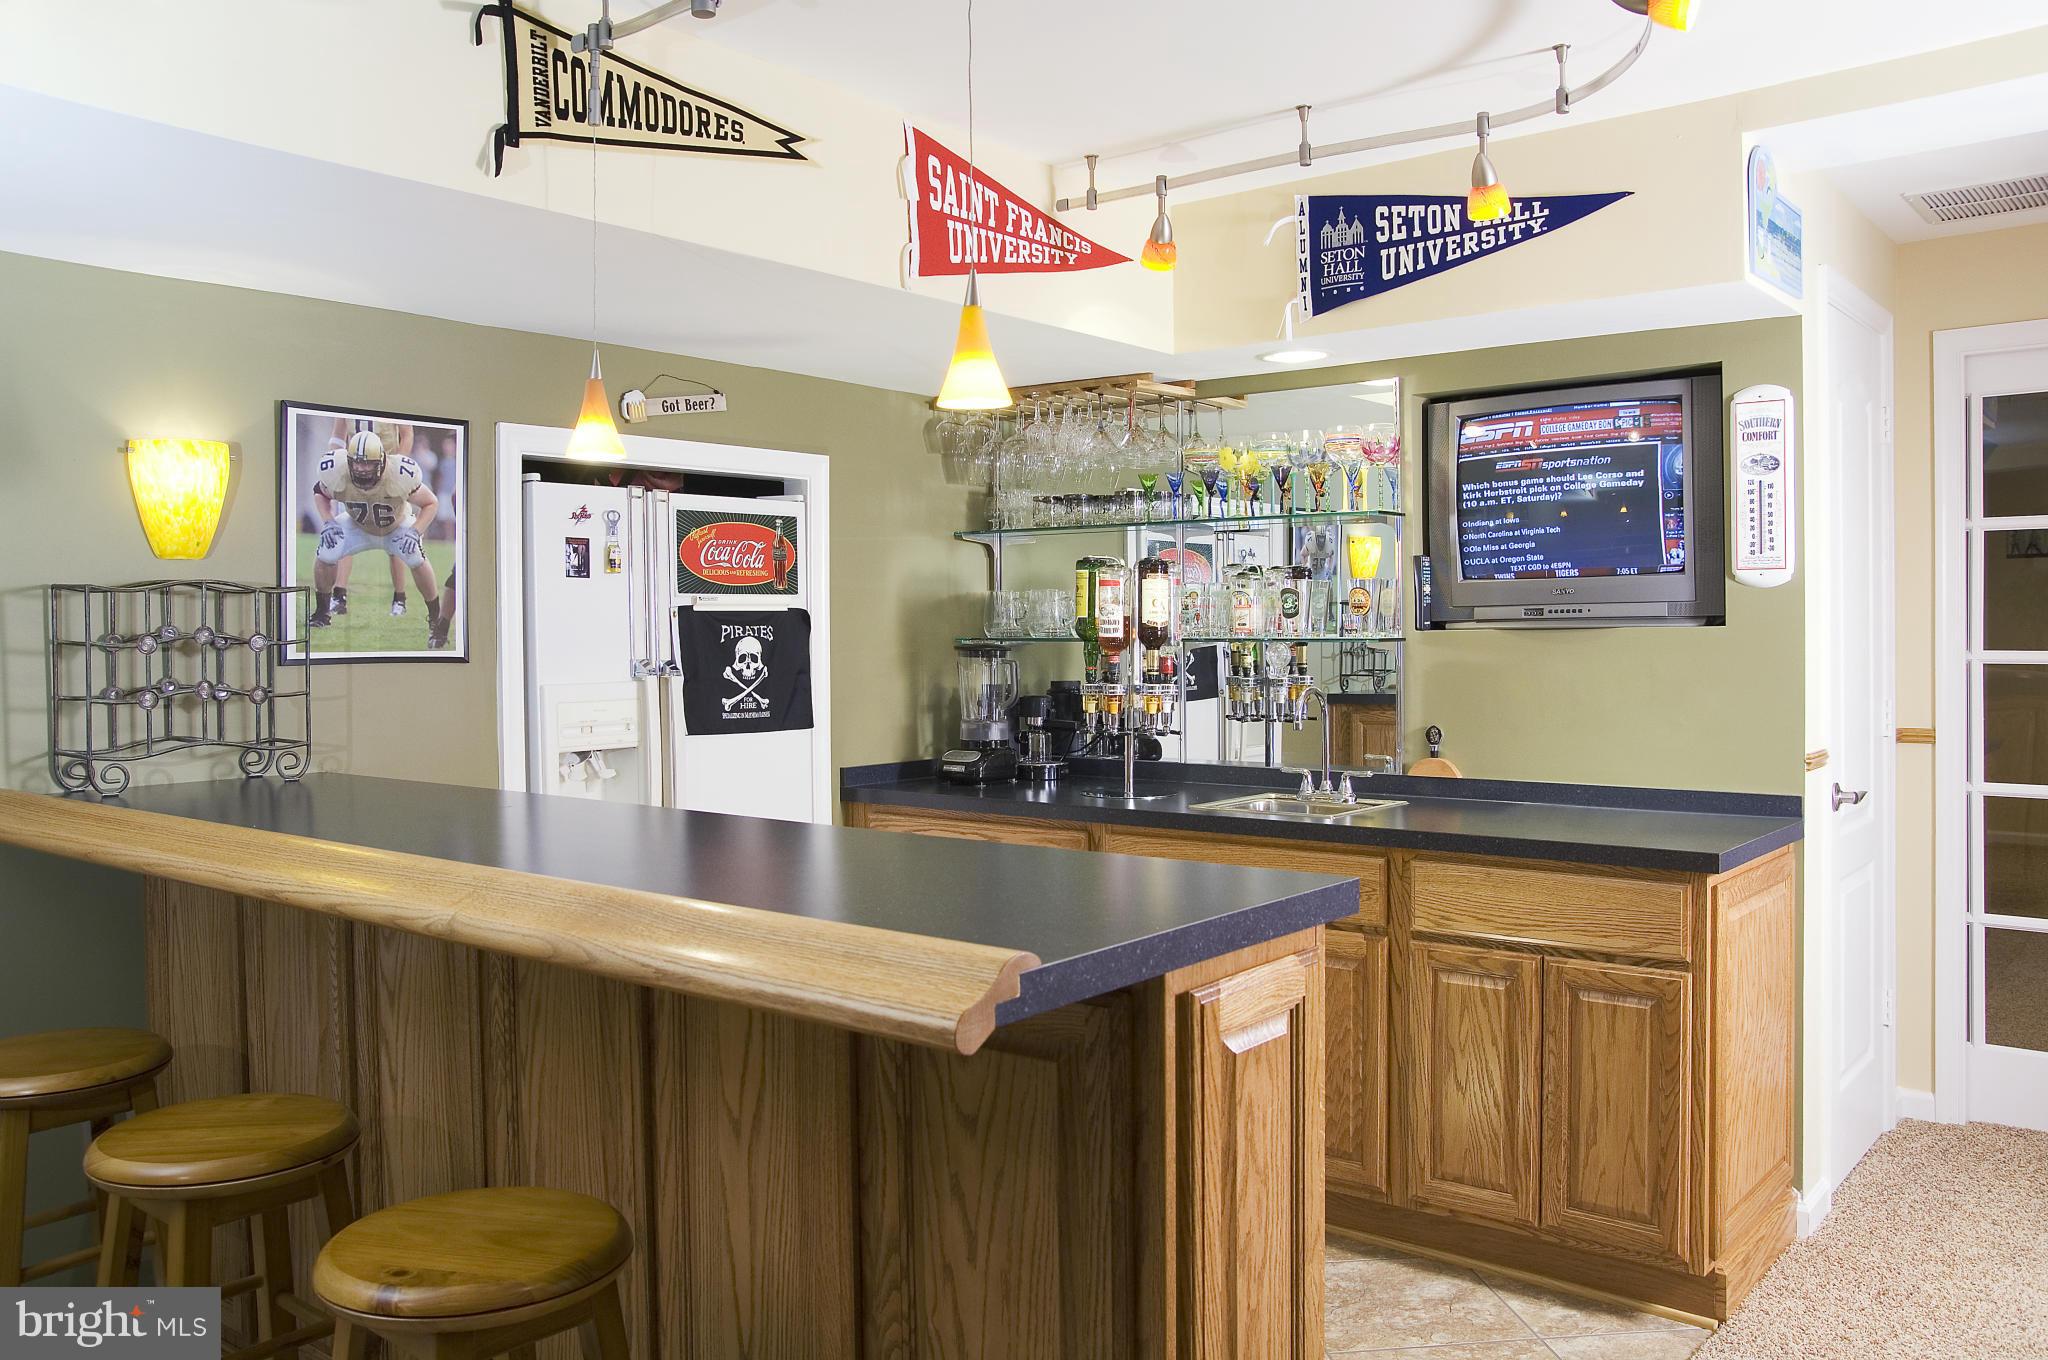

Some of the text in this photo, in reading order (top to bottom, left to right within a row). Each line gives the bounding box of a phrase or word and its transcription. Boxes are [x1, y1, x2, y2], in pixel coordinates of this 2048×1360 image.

[530, 29, 551, 127] VANDERBILT
[927, 154, 1092, 254] SAINT FRANCIS
[1376, 201, 1550, 243] SETON LL
[947, 219, 1079, 265] UNIVERSITY
[1298, 201, 1308, 312] ALUMNI
[1320, 246, 1366, 264] SETON
[1323, 260, 1363, 277] HALL
[1320, 272, 1365, 286] UNIVERSITY
[661, 397, 715, 413] Got Beer?
[1738, 416, 1782, 431] SOUTHERN
[1742, 430, 1778, 442] COMFORT
[1462, 482, 1490, 491] Which
[1492, 479, 1519, 488] bonus
[1521, 477, 1544, 486] game
[1546, 473, 1575, 482] should
[1595, 471, 1624, 479] Corso
[1625, 469, 1645, 477] and
[1463, 490, 1482, 499] Kirk
[1484, 486, 1527, 498] Herbstreit
[1529, 484, 1549, 494] pick
[1563, 480, 1597, 491] College
[1599, 478, 1644, 489] Gameday
[1462, 491, 1563, 509] (10 a.m. ET, Saturday)?
[346, 502, 396, 528] 76
[1487, 529, 1514, 539] Carolina
[1521, 526, 1545, 536] Virginia
[1545, 526, 1561, 534] Tech
[1469, 544, 1482, 552] Ole
[1482, 543, 1500, 552] Miss
[1508, 541, 1536, 550] Georgia
[1470, 557, 1491, 565] UCLA
[1499, 555, 1525, 564] Oregon
[1526, 553, 1544, 561] State
[702, 568, 730, 576] DELICIOUS
[736, 569, 769, 577] REFRESHING
[1510, 564, 1526, 572] TEXT
[1555, 569, 1580, 577] TIGERS
[720, 624, 774, 643] PIRATES
[739, 702, 758, 710] HIRE
